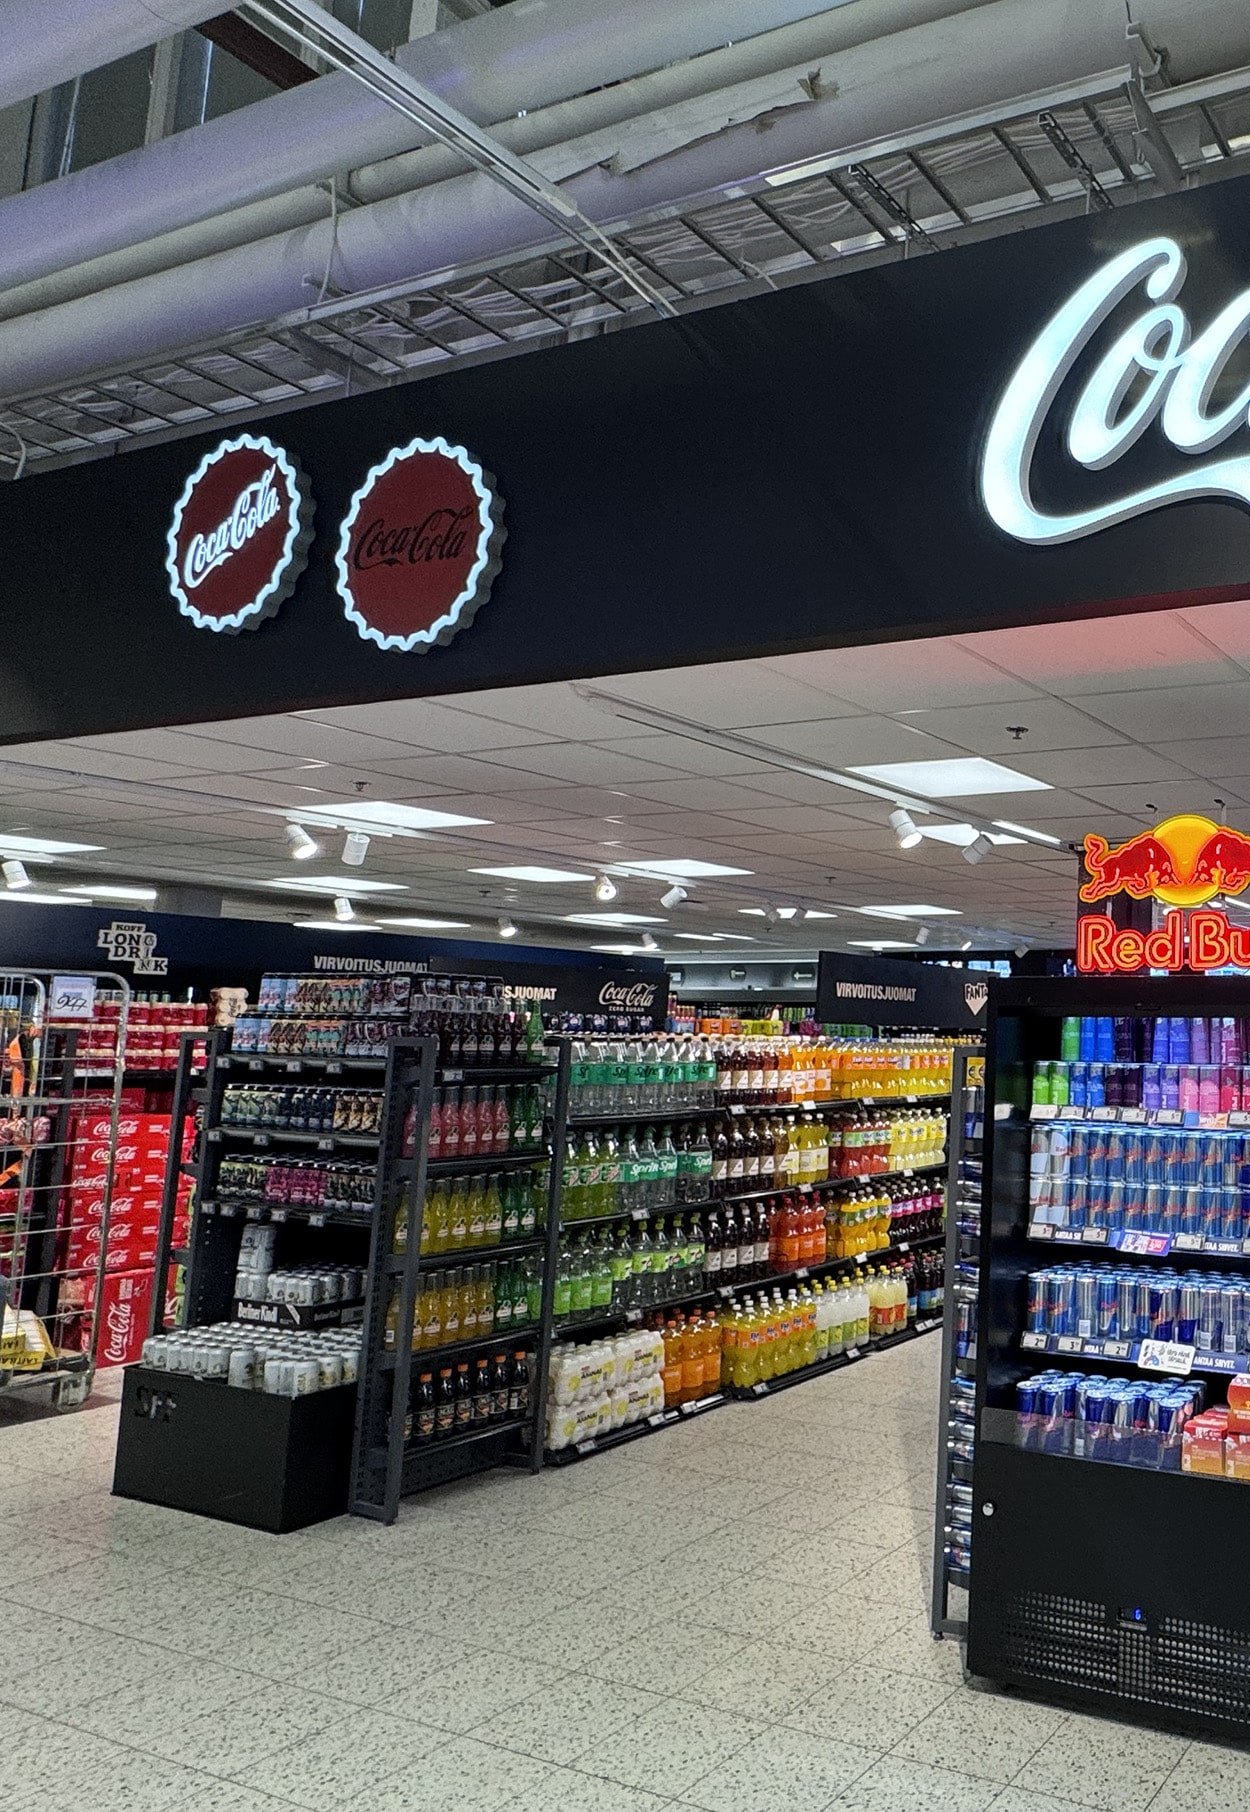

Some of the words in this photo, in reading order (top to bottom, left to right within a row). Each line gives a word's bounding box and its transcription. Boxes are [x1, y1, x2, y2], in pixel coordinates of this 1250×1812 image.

[184, 463, 281, 588] Coca-Cola
[353, 505, 473, 571] Coca-Cola
[102, 932, 155, 947] LONG
[115, 924, 144, 932] KOFF
[1077, 909, 1183, 972] Red
[502, 985, 557, 1001] SJUOMAT
[598, 981, 659, 1007] Coca-Cola
[836, 982, 917, 1002] VIRVOITUSJUOMAT
[237, 1301, 260, 1320] Berliner
[260, 1304, 278, 1323] Kindl
[104, 1302, 132, 1362] Coca-Cola
